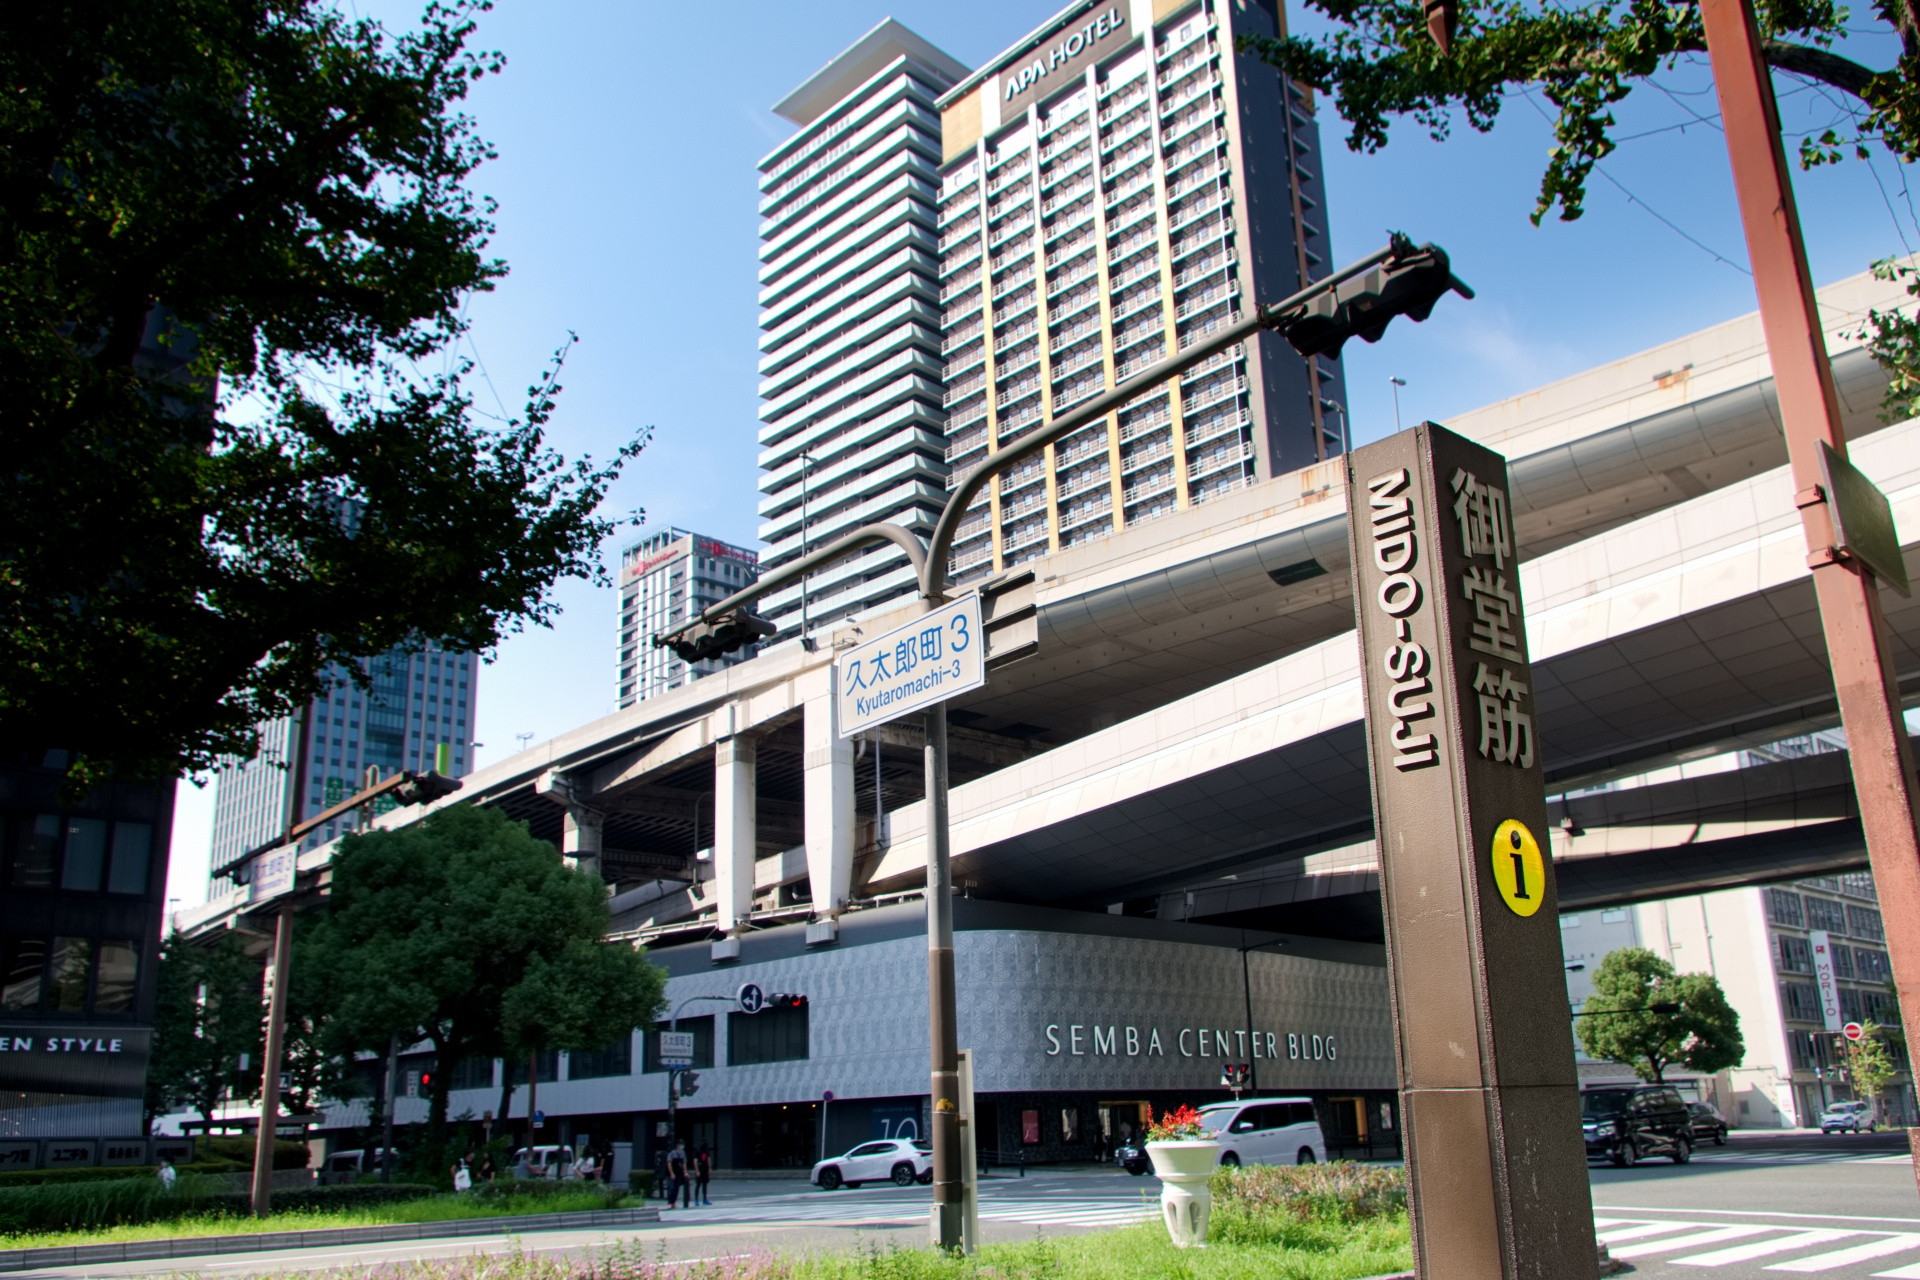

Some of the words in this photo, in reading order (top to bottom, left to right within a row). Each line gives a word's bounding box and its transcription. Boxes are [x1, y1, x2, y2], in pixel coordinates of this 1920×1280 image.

[1005, 58, 1048, 101] APA
[1049, 7, 1125, 71] HOTEL
[1367, 467, 1439, 771] MIDO-SUJI
[1449, 465, 1535, 770] 御堂筋
[856, 660, 961, 717] Kyutaromachi-3
[1817, 963, 1837, 1017] MORITO
[46, 1037, 123, 1053] STYLE
[1045, 1023, 1164, 1057] SEMBA
[1178, 1028, 1279, 1059] CENTER
[1289, 1032, 1337, 1061] BLDG
